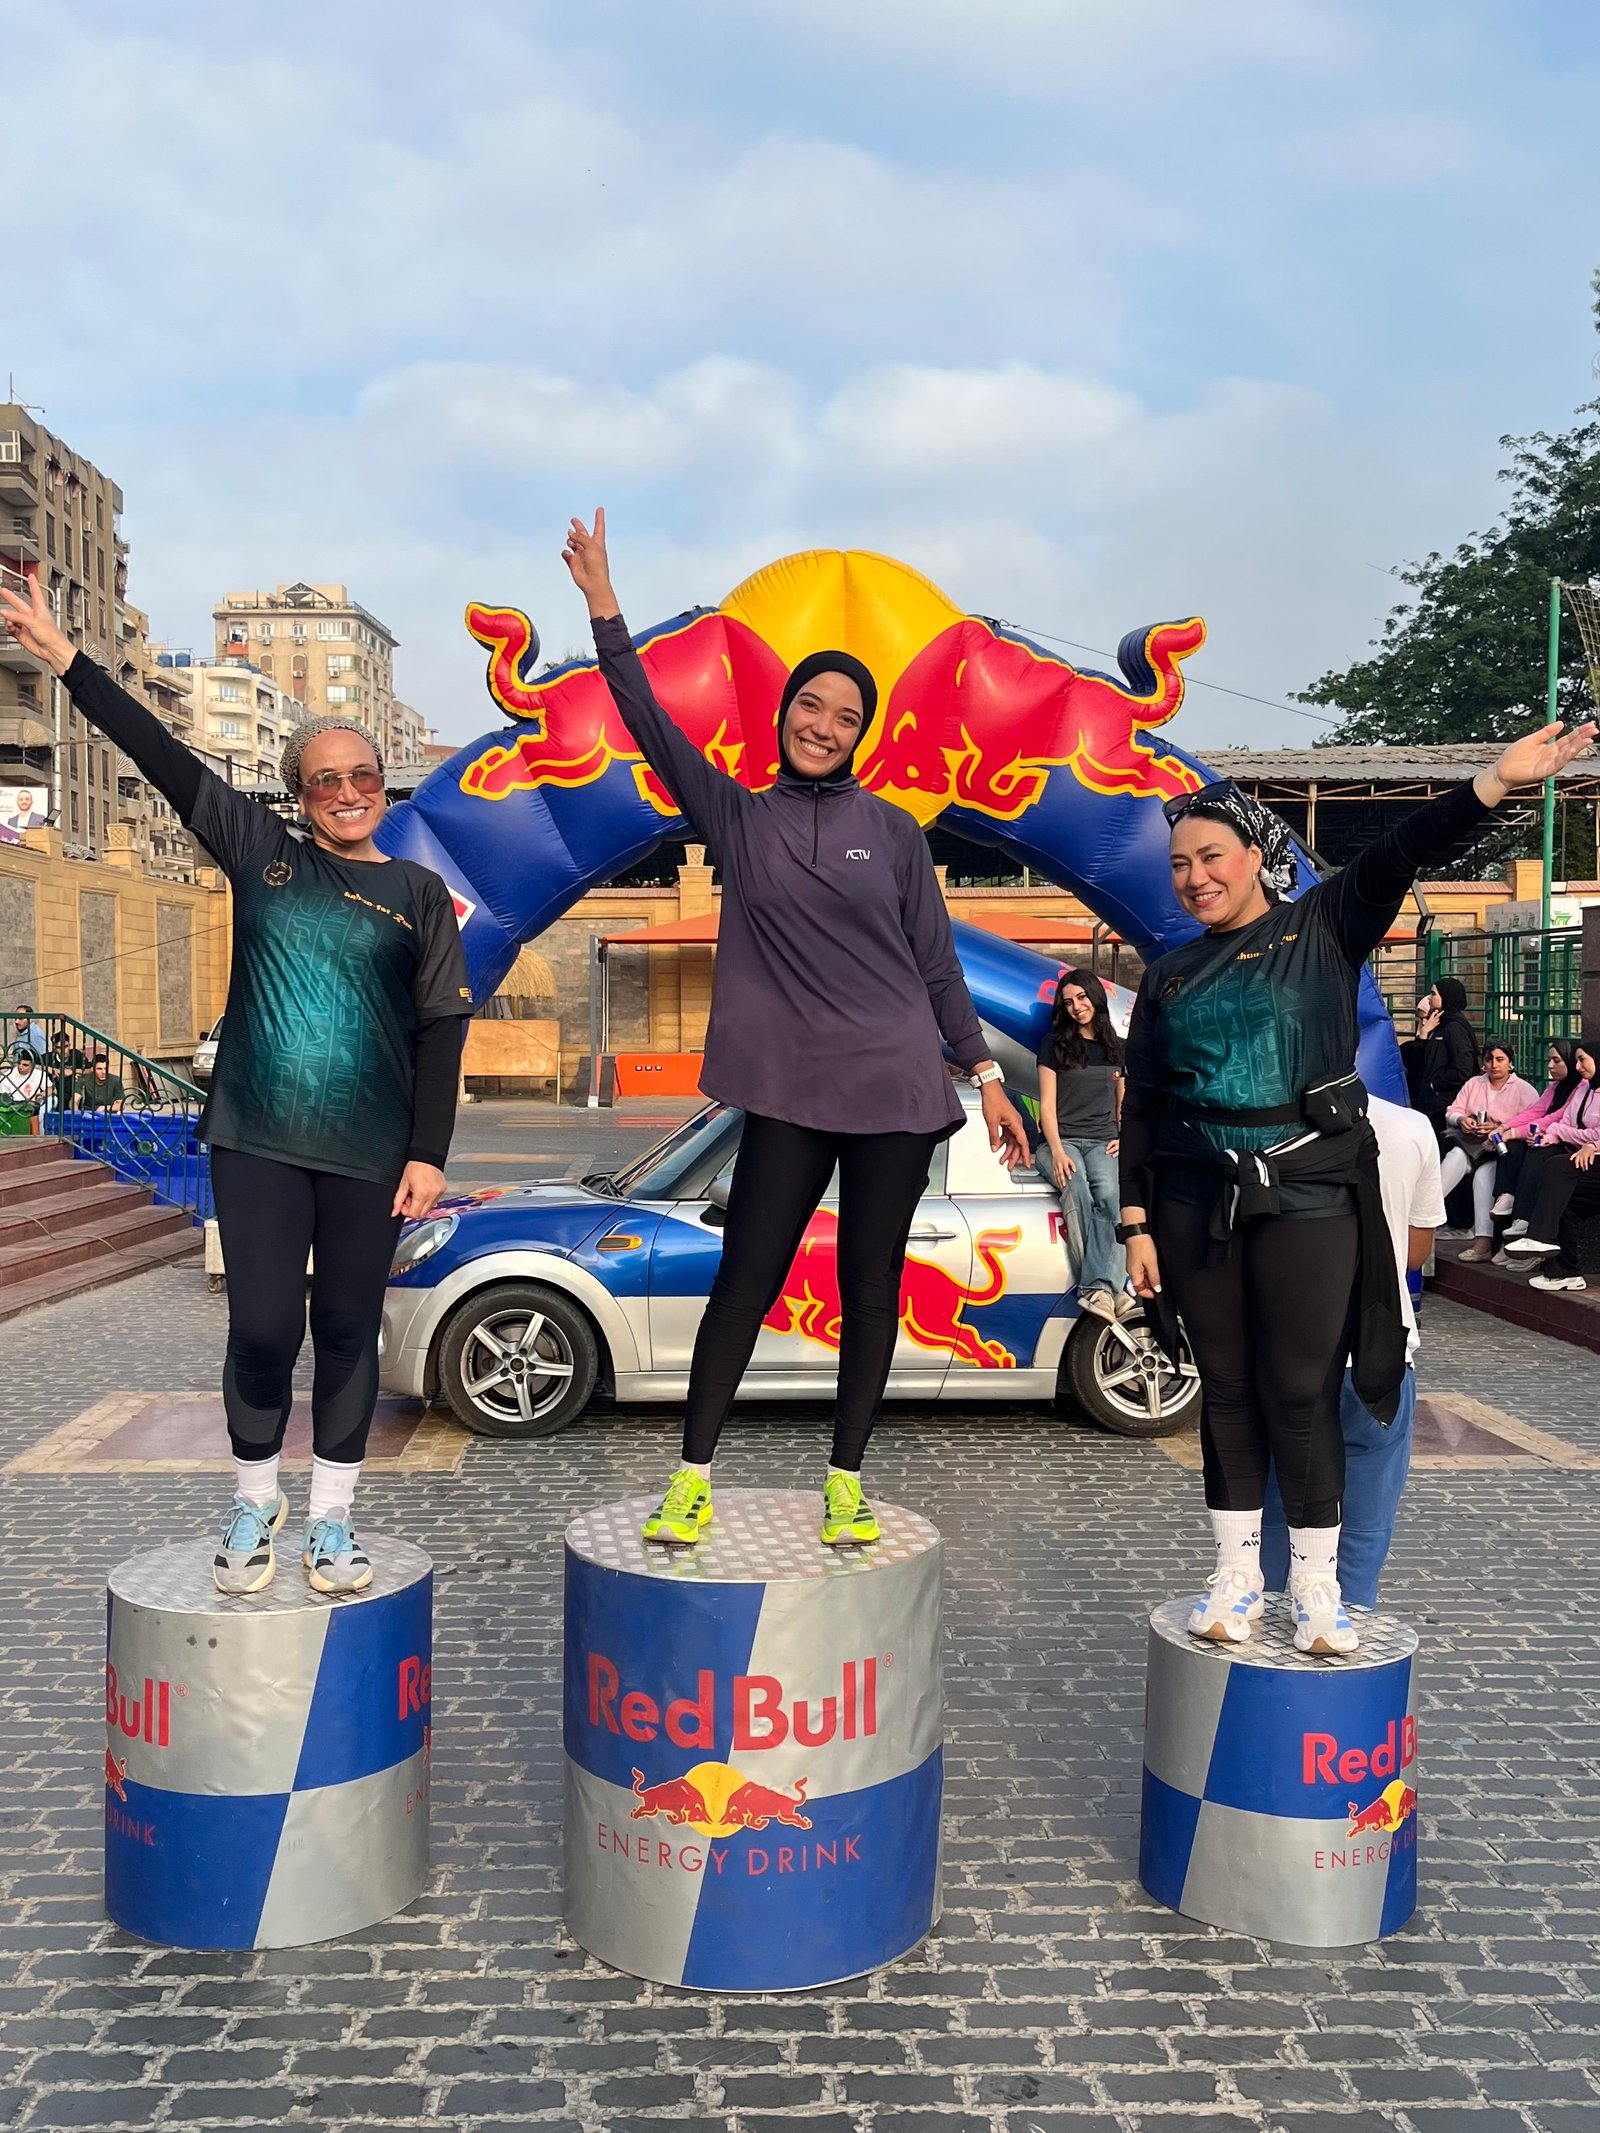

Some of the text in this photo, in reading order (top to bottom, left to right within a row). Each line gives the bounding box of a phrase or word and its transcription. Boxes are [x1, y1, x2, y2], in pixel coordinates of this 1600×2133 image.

[588, 1651, 877, 1751] Red Bull
[1303, 1715, 1417, 1785] Red B
[598, 1822, 862, 1876] ENERGY DRINK
[1314, 1839, 1399, 1869] ENERGY
